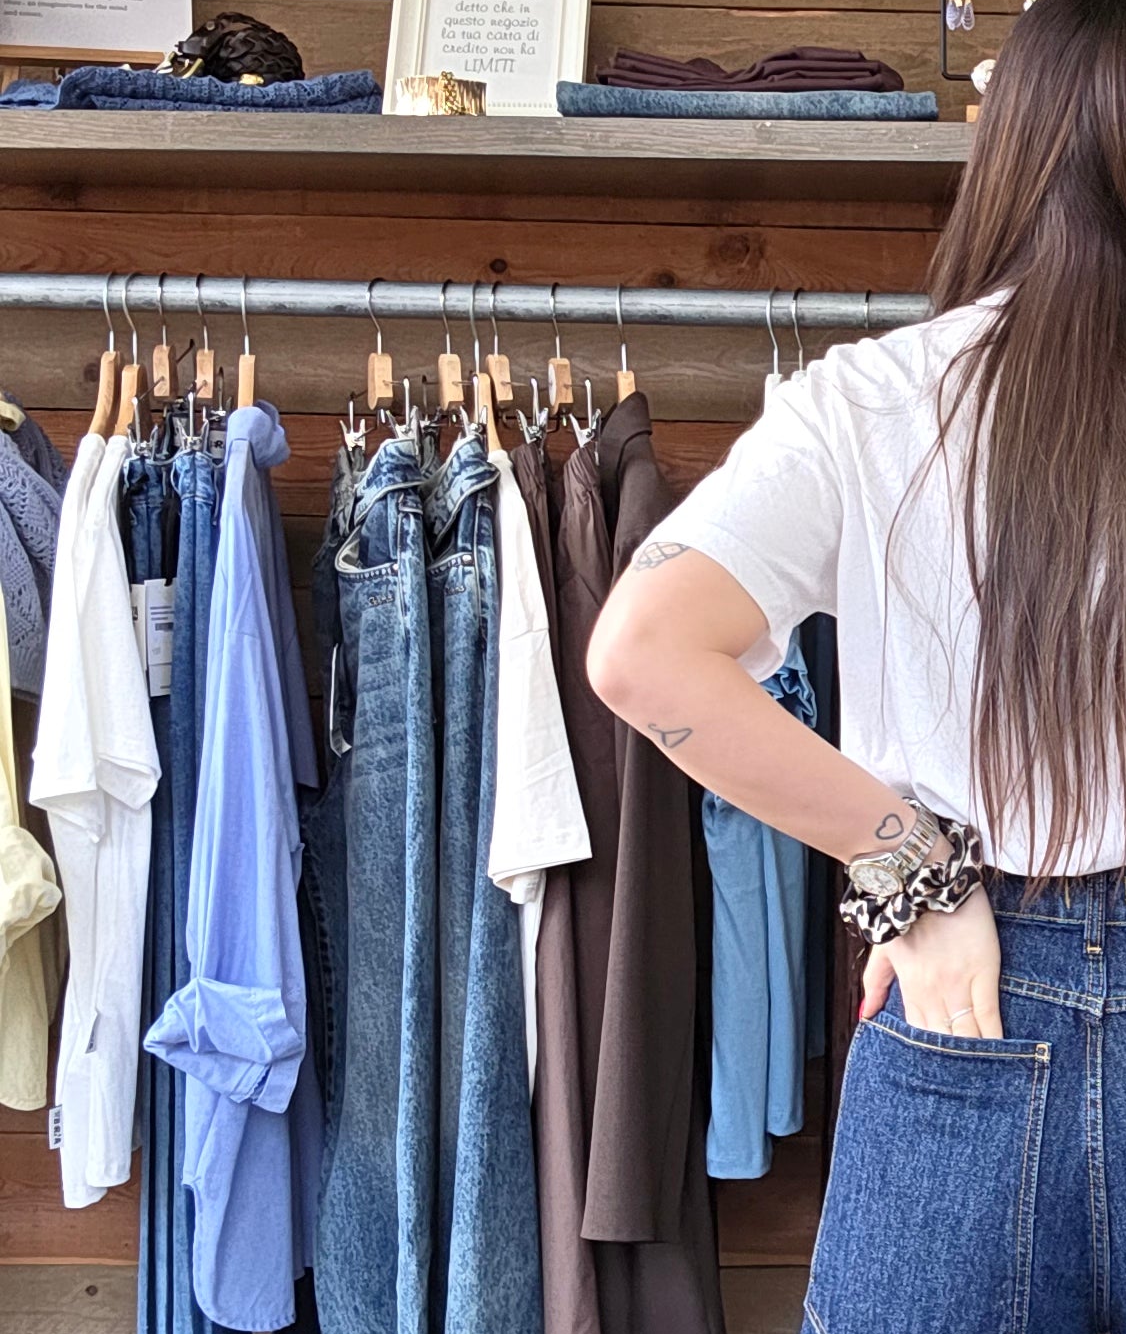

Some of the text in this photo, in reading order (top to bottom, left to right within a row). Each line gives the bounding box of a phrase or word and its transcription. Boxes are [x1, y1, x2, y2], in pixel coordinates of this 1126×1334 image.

[455, 0, 530, 13] detto che in
[444, 17, 539, 30] questo negozio
[441, 27, 540, 41] la tua carta di
[442, 42, 536, 55] credito non ha
[464, 57, 516, 73] LIMITI
